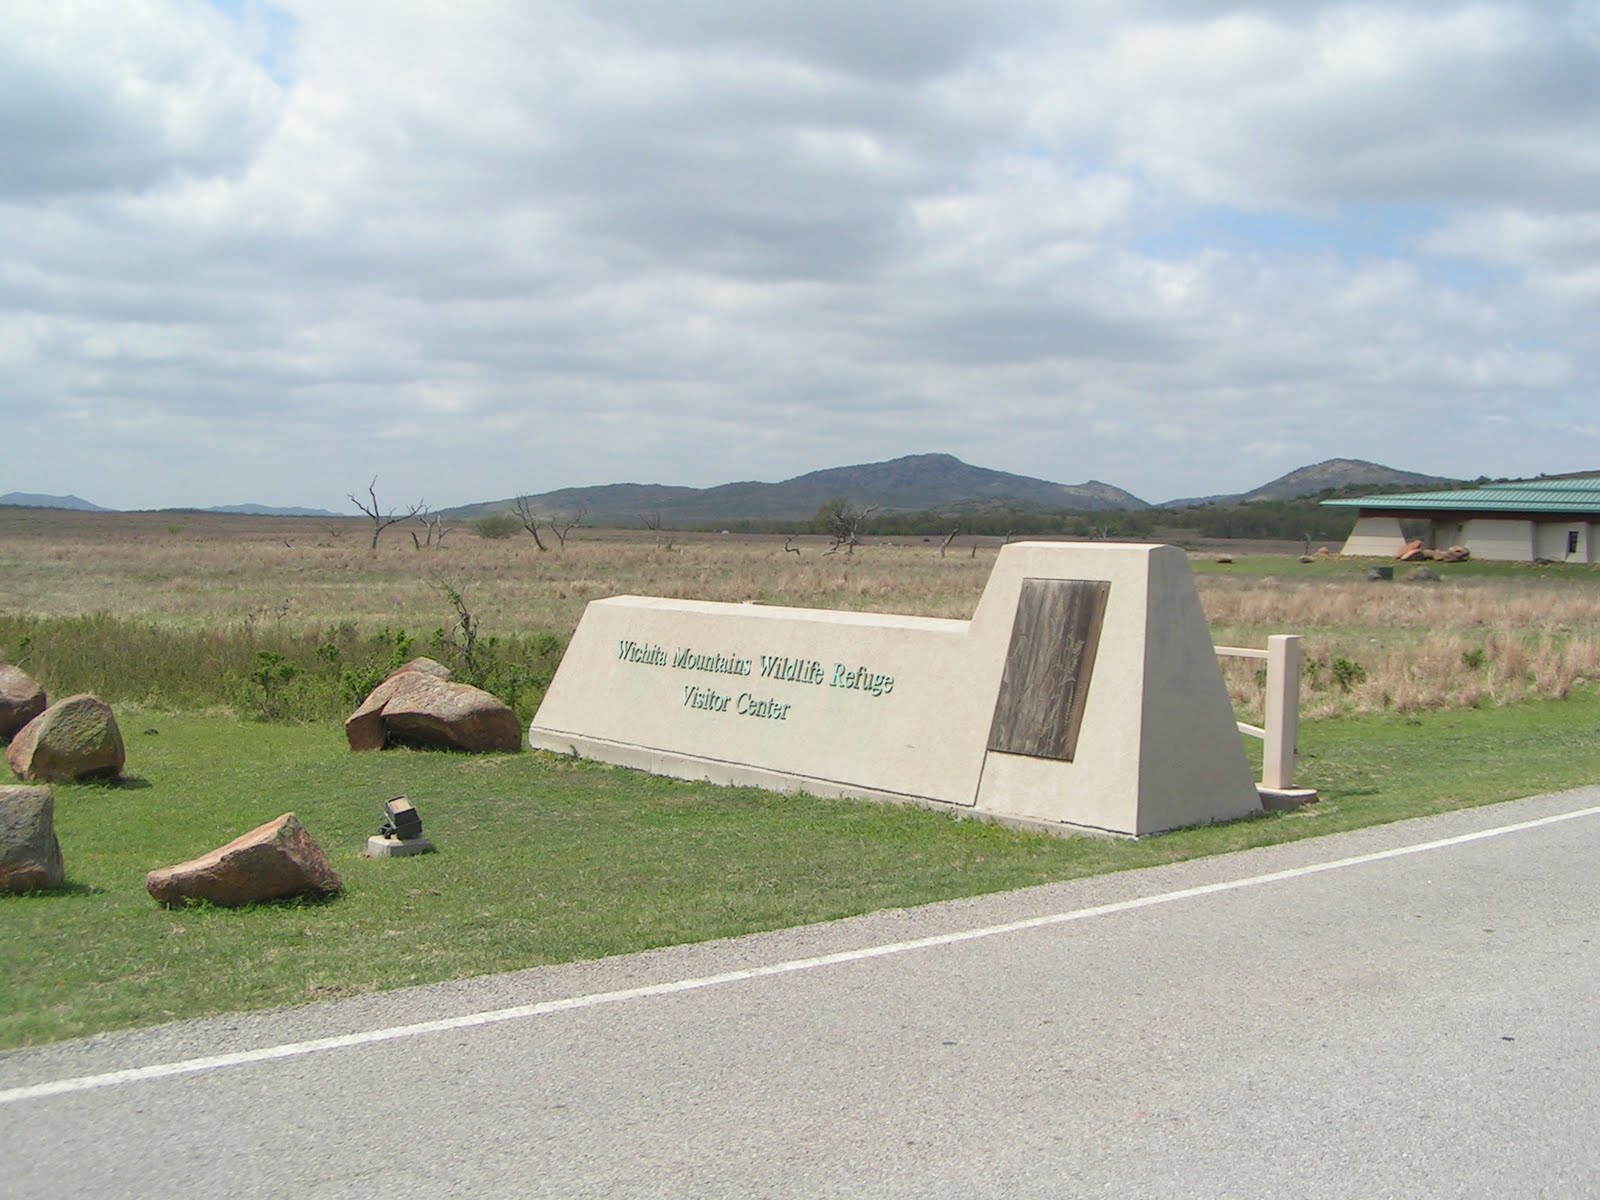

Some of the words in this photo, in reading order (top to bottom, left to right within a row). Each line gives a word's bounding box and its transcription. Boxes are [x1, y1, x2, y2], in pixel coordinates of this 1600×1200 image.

[619, 640, 667, 666] Wichita
[672, 647, 752, 676] Mountains
[760, 656, 824, 685] Wildlife
[829, 663, 894, 697] Refuge
[684, 686, 731, 712] Visitor
[737, 693, 791, 720] Center
